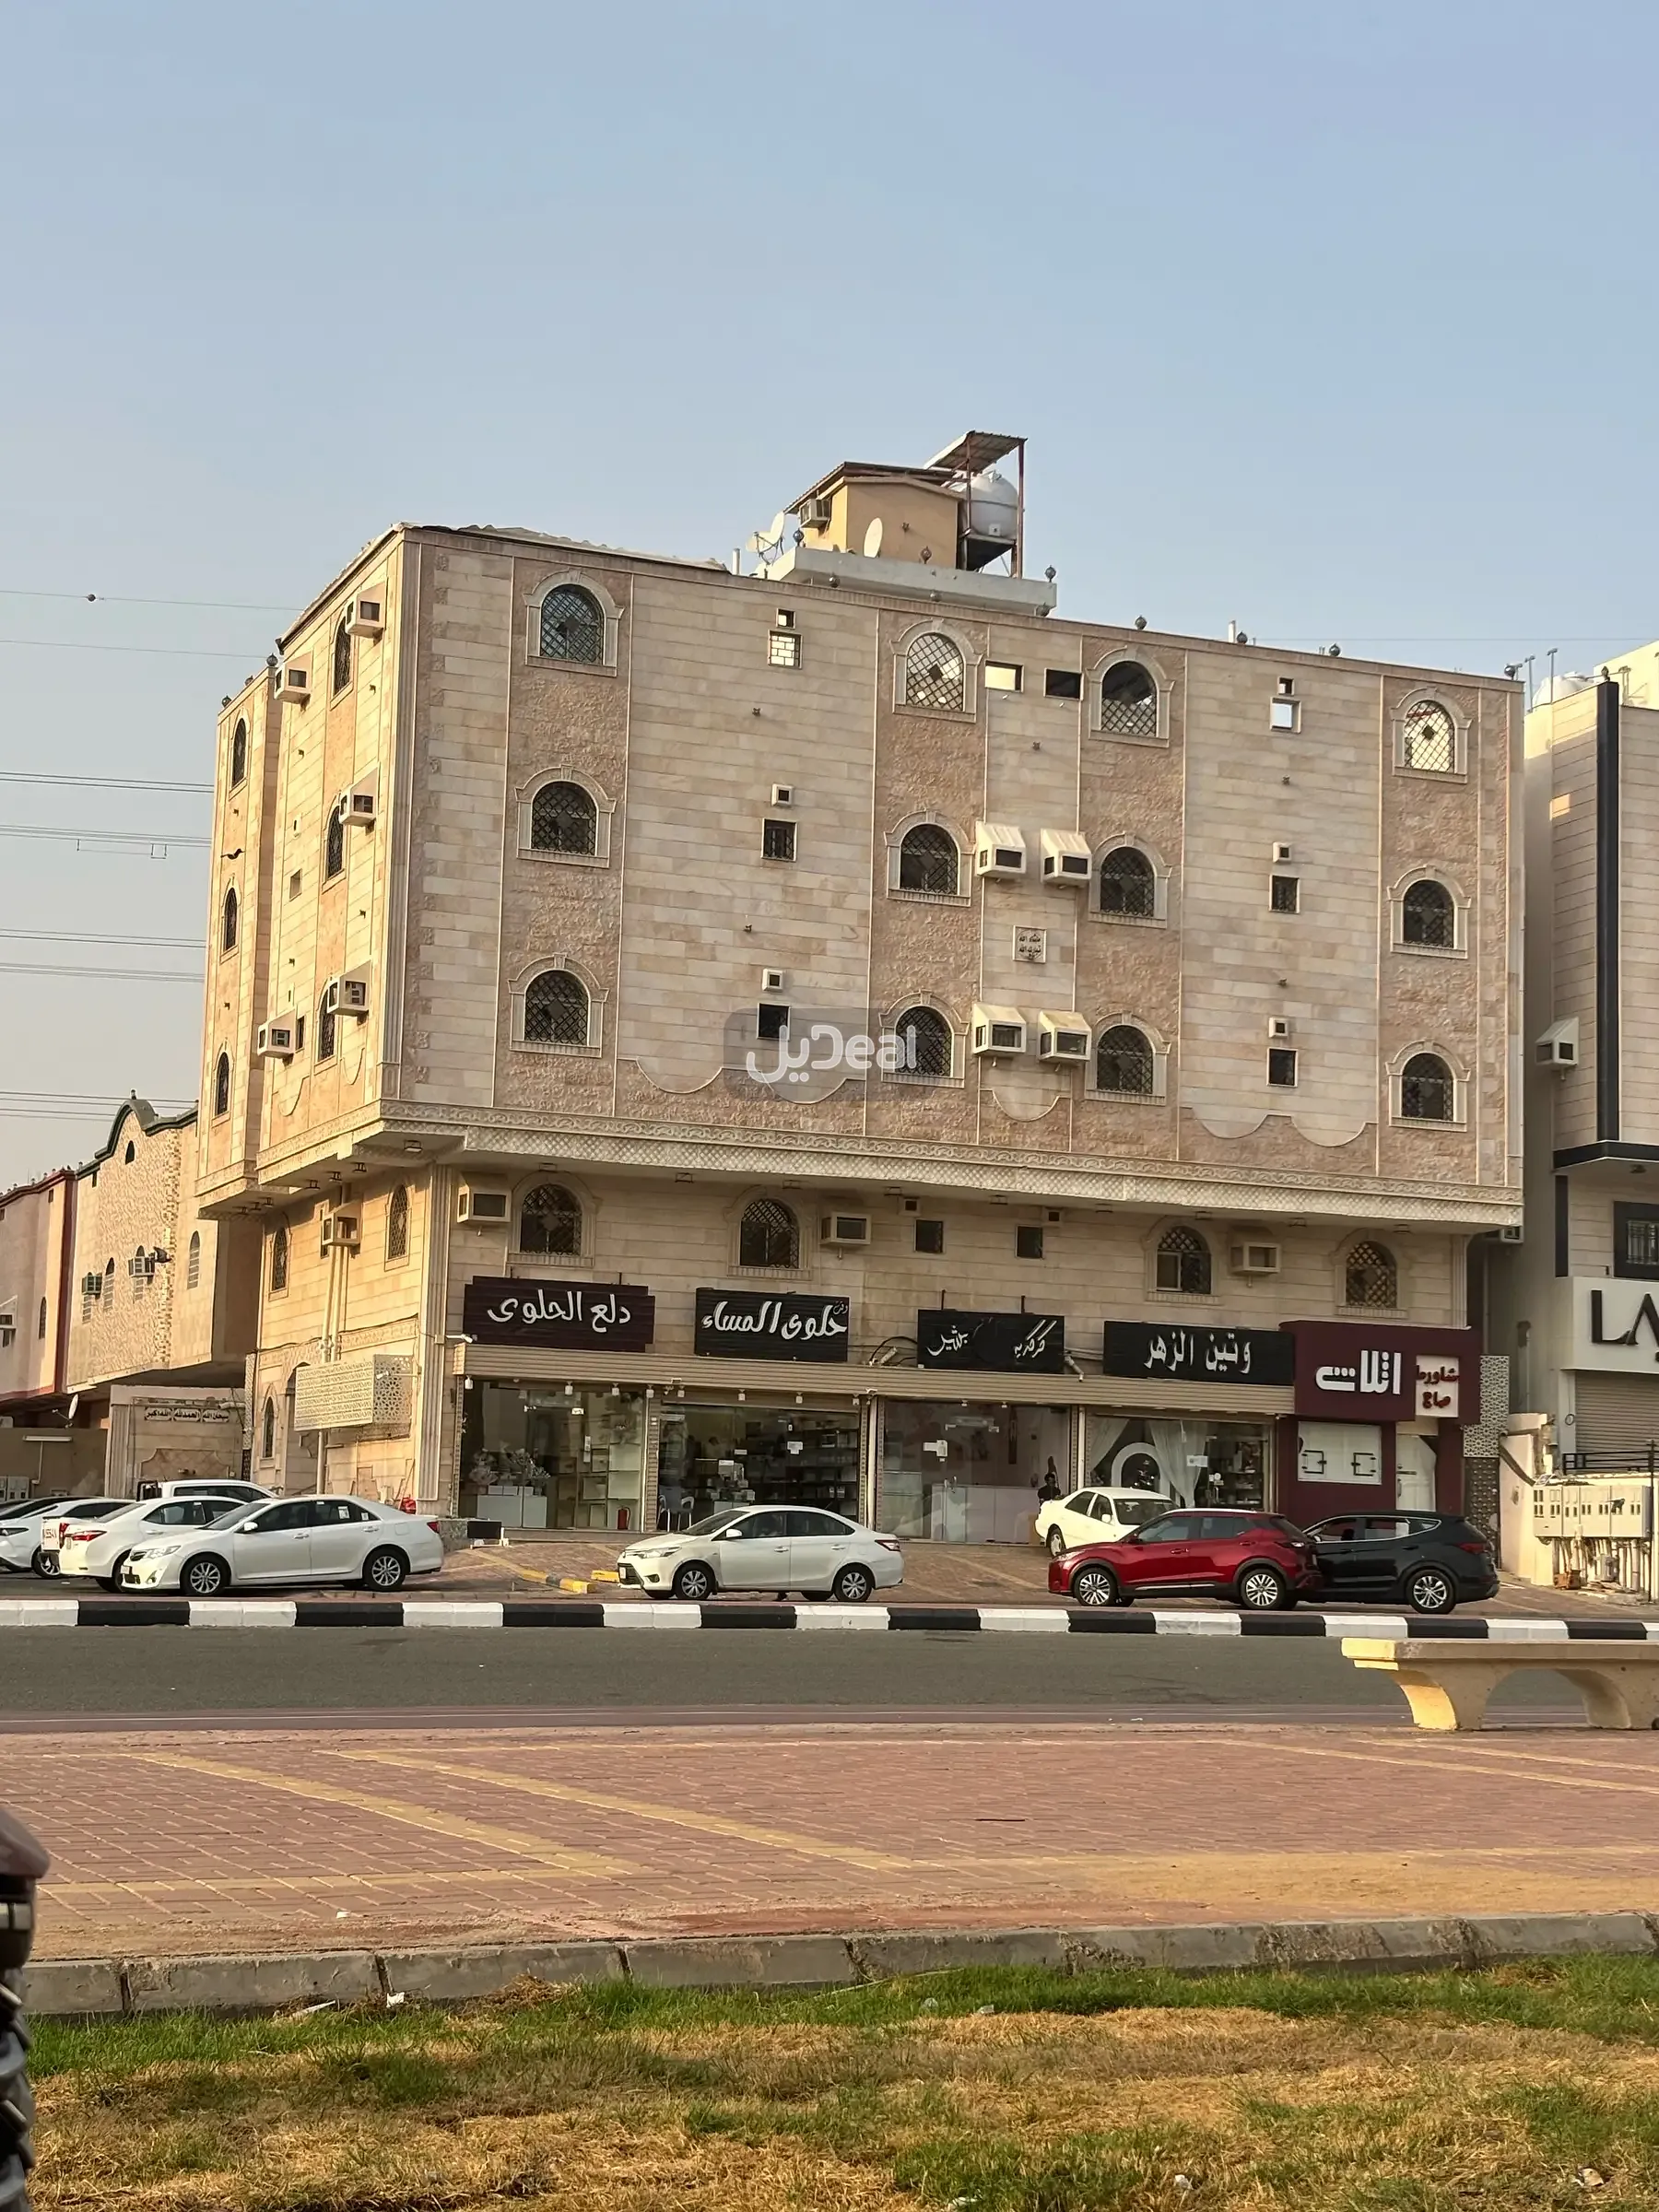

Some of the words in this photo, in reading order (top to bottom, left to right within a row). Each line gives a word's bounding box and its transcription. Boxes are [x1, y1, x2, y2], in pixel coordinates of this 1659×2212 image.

[487, 1288, 582, 1324] الحلوى
[591, 1293, 631, 1334] دلع
[701, 1300, 782, 1334] المساء
[779, 1303, 848, 1341] حلوى
[1144, 1329, 1194, 1371] الزهر
[1206, 1333, 1252, 1374] وتين
[1422, 1391, 1451, 1409] صاج
